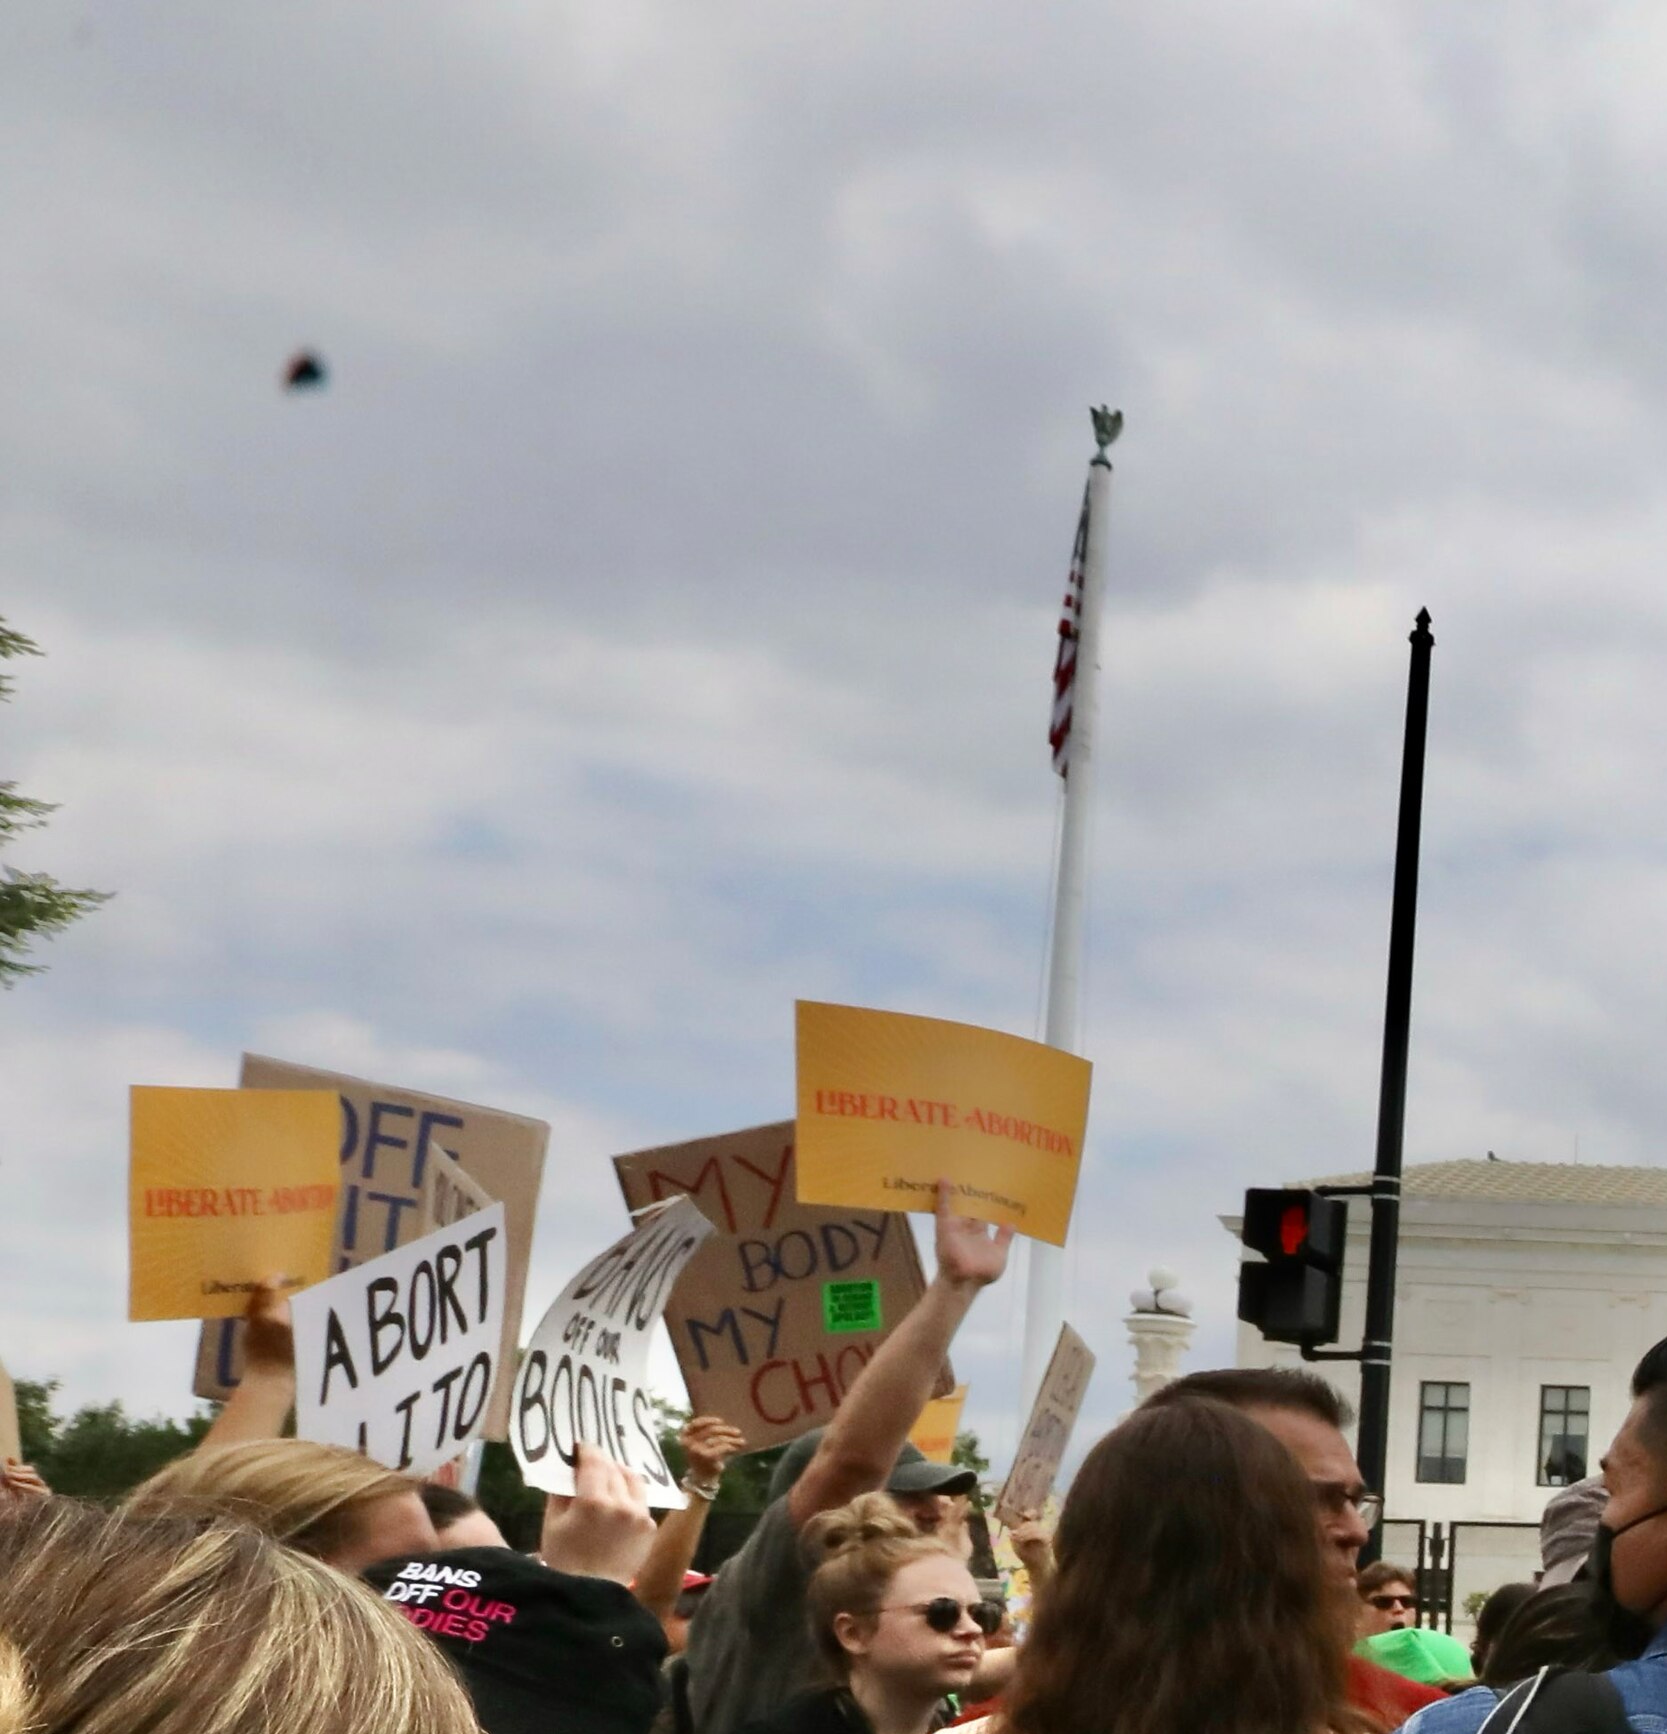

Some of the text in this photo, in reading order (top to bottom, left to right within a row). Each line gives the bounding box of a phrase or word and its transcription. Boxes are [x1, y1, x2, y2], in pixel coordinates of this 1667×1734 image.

[815, 1088, 1075, 1157] LIBERATE ABORTION
[145, 1186, 265, 1217] LIBERATE
[646, 1145, 795, 1234] MY
[738, 1212, 890, 1293] BODY
[319, 1226, 497, 1408] ABORT
[685, 1296, 784, 1371] MY
[519, 1350, 670, 1488] BODIES
[750, 1341, 877, 1425] CHO
[383, 1581, 517, 1624] OFF OUR
[397, 1561, 482, 1588] BANS
